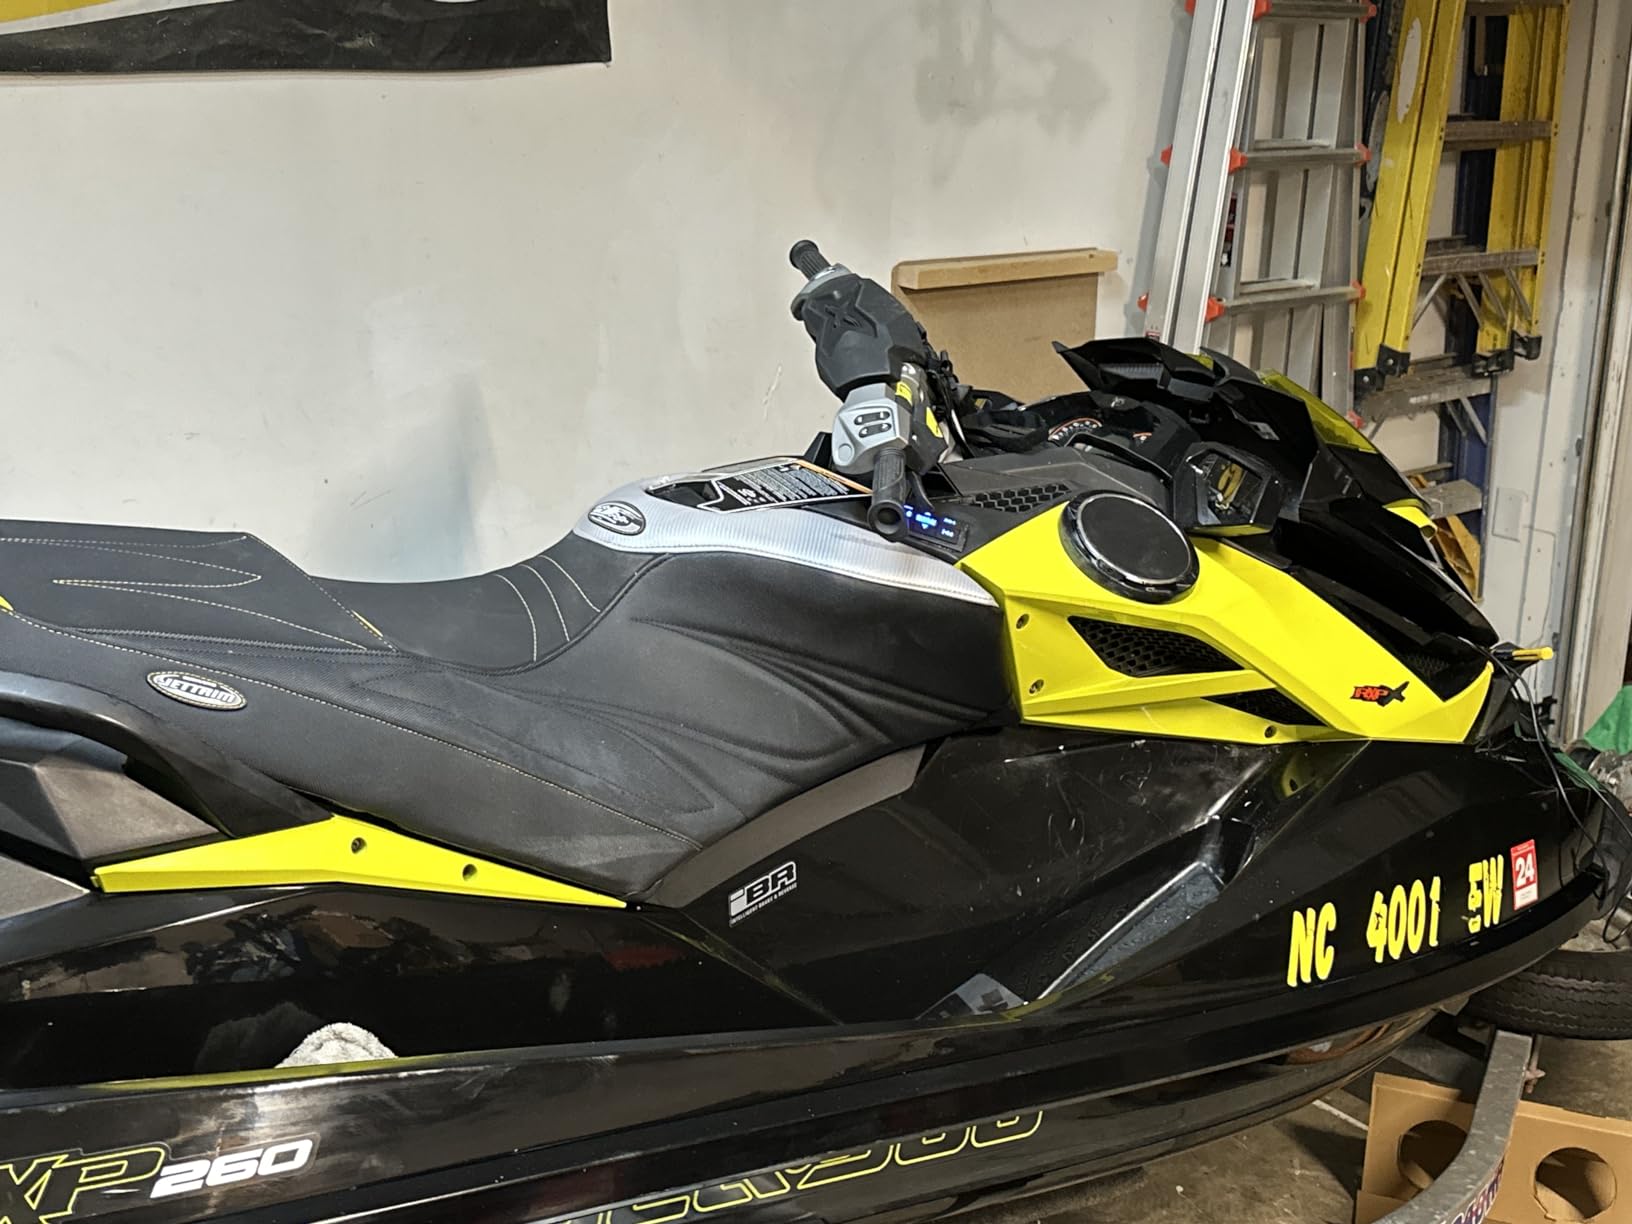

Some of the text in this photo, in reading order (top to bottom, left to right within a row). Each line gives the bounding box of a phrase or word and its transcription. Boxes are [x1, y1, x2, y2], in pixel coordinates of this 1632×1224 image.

[1515, 852, 1535, 889] 24
[1287, 902, 1337, 988] NC
[1366, 876, 1441, 963] 4001
[150, 1139, 313, 1198] 260
